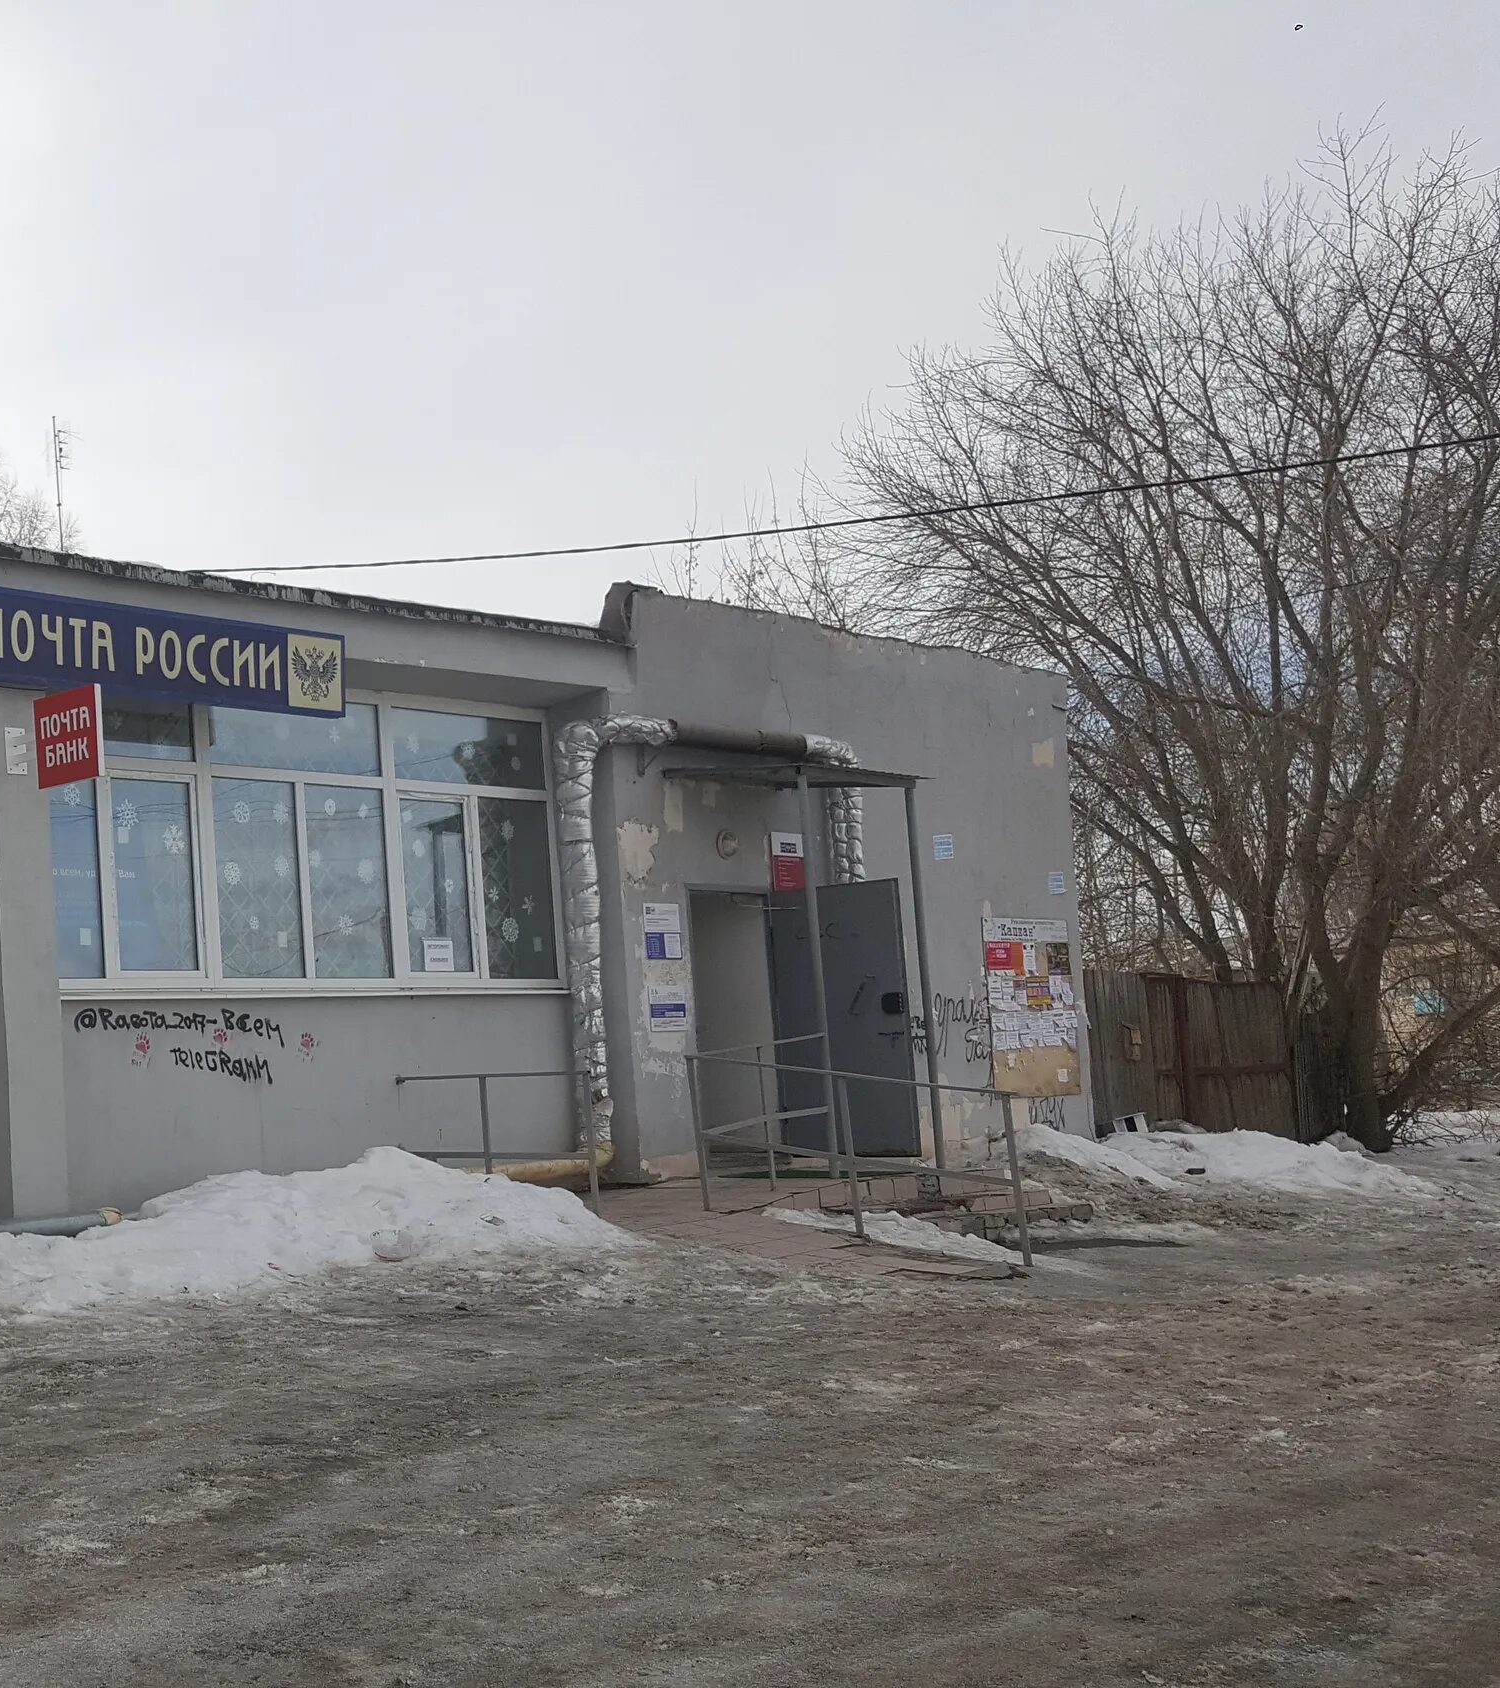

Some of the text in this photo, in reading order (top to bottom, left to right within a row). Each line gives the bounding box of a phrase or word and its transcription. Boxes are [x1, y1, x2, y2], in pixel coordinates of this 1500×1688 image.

[136, 626, 282, 692] РОССИИ
[39, 705, 91, 740] ПОЧТА
[44, 736, 90, 768] БАНК
